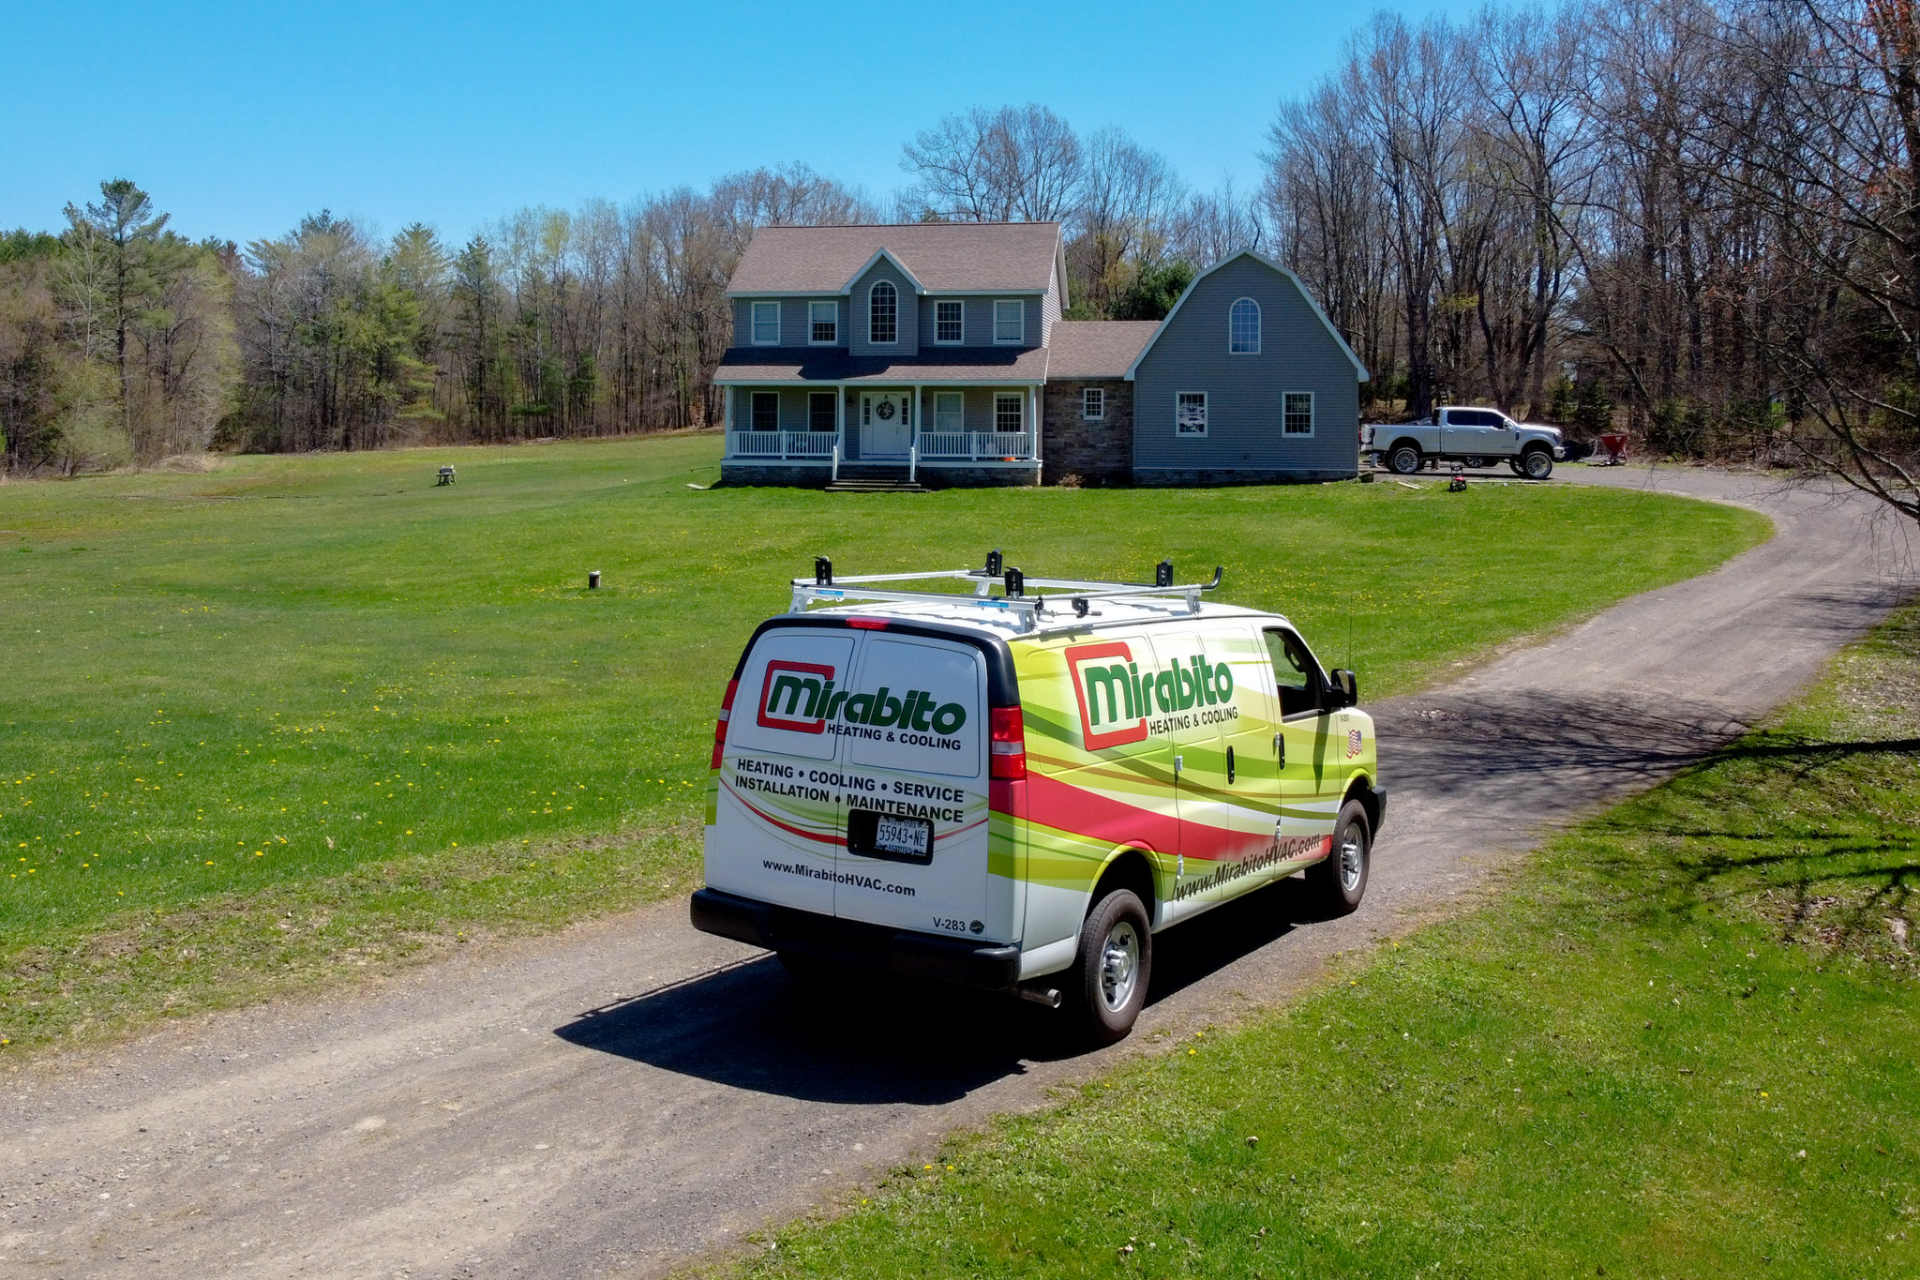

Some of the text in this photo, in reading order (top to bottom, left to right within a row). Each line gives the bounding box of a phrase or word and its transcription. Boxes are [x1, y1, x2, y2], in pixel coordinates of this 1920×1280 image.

[767, 675, 967, 735] Mirabito
[1085, 654, 1234, 726] Mirabito
[827, 724, 961, 751] HEATING & COOLING
[1150, 706, 1239, 736] HEATING & COOLING
[735, 775, 964, 823] INSTALLATION MAINTENANCE
[737, 758, 964, 803] HEATING COOLING SERVICE
[762, 859, 916, 897] www.MirabitoHVAC.com
[1176, 833, 1321, 902] www.MirabitoHVAC.com
[932, 916, 966, 932] V-283
